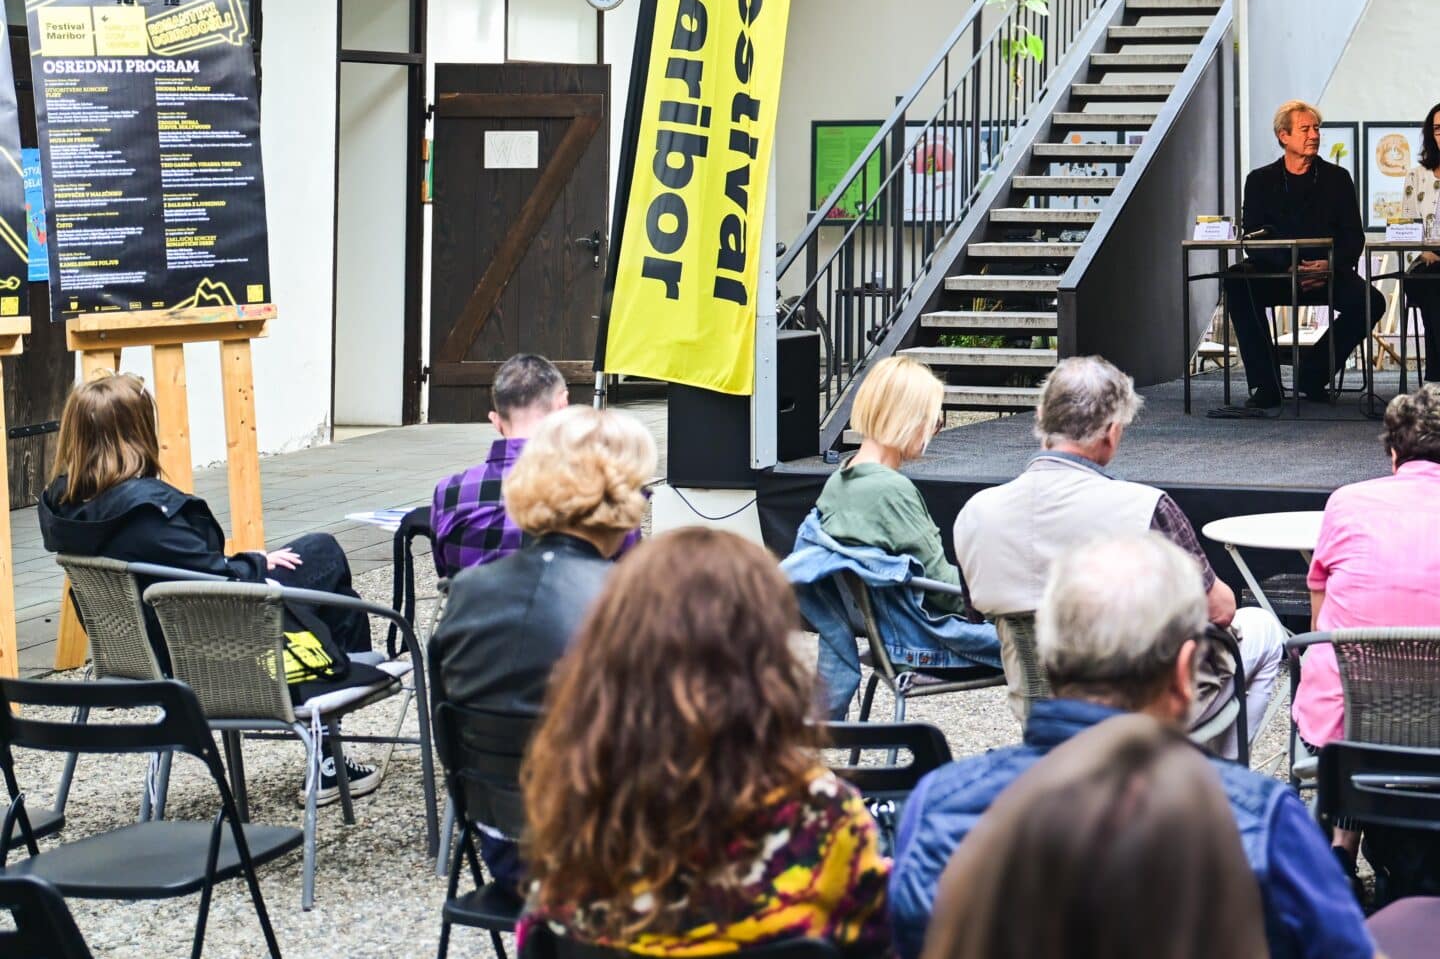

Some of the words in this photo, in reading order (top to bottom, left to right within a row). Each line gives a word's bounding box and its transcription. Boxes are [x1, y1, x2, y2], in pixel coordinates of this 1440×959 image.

[45, 23, 85, 31] Festival
[46, 32, 86, 40] Maribor
[43, 60, 122, 74] OSREDNJI
[125, 60, 200, 73] PROGRAM
[487, 135, 534, 164] WC
